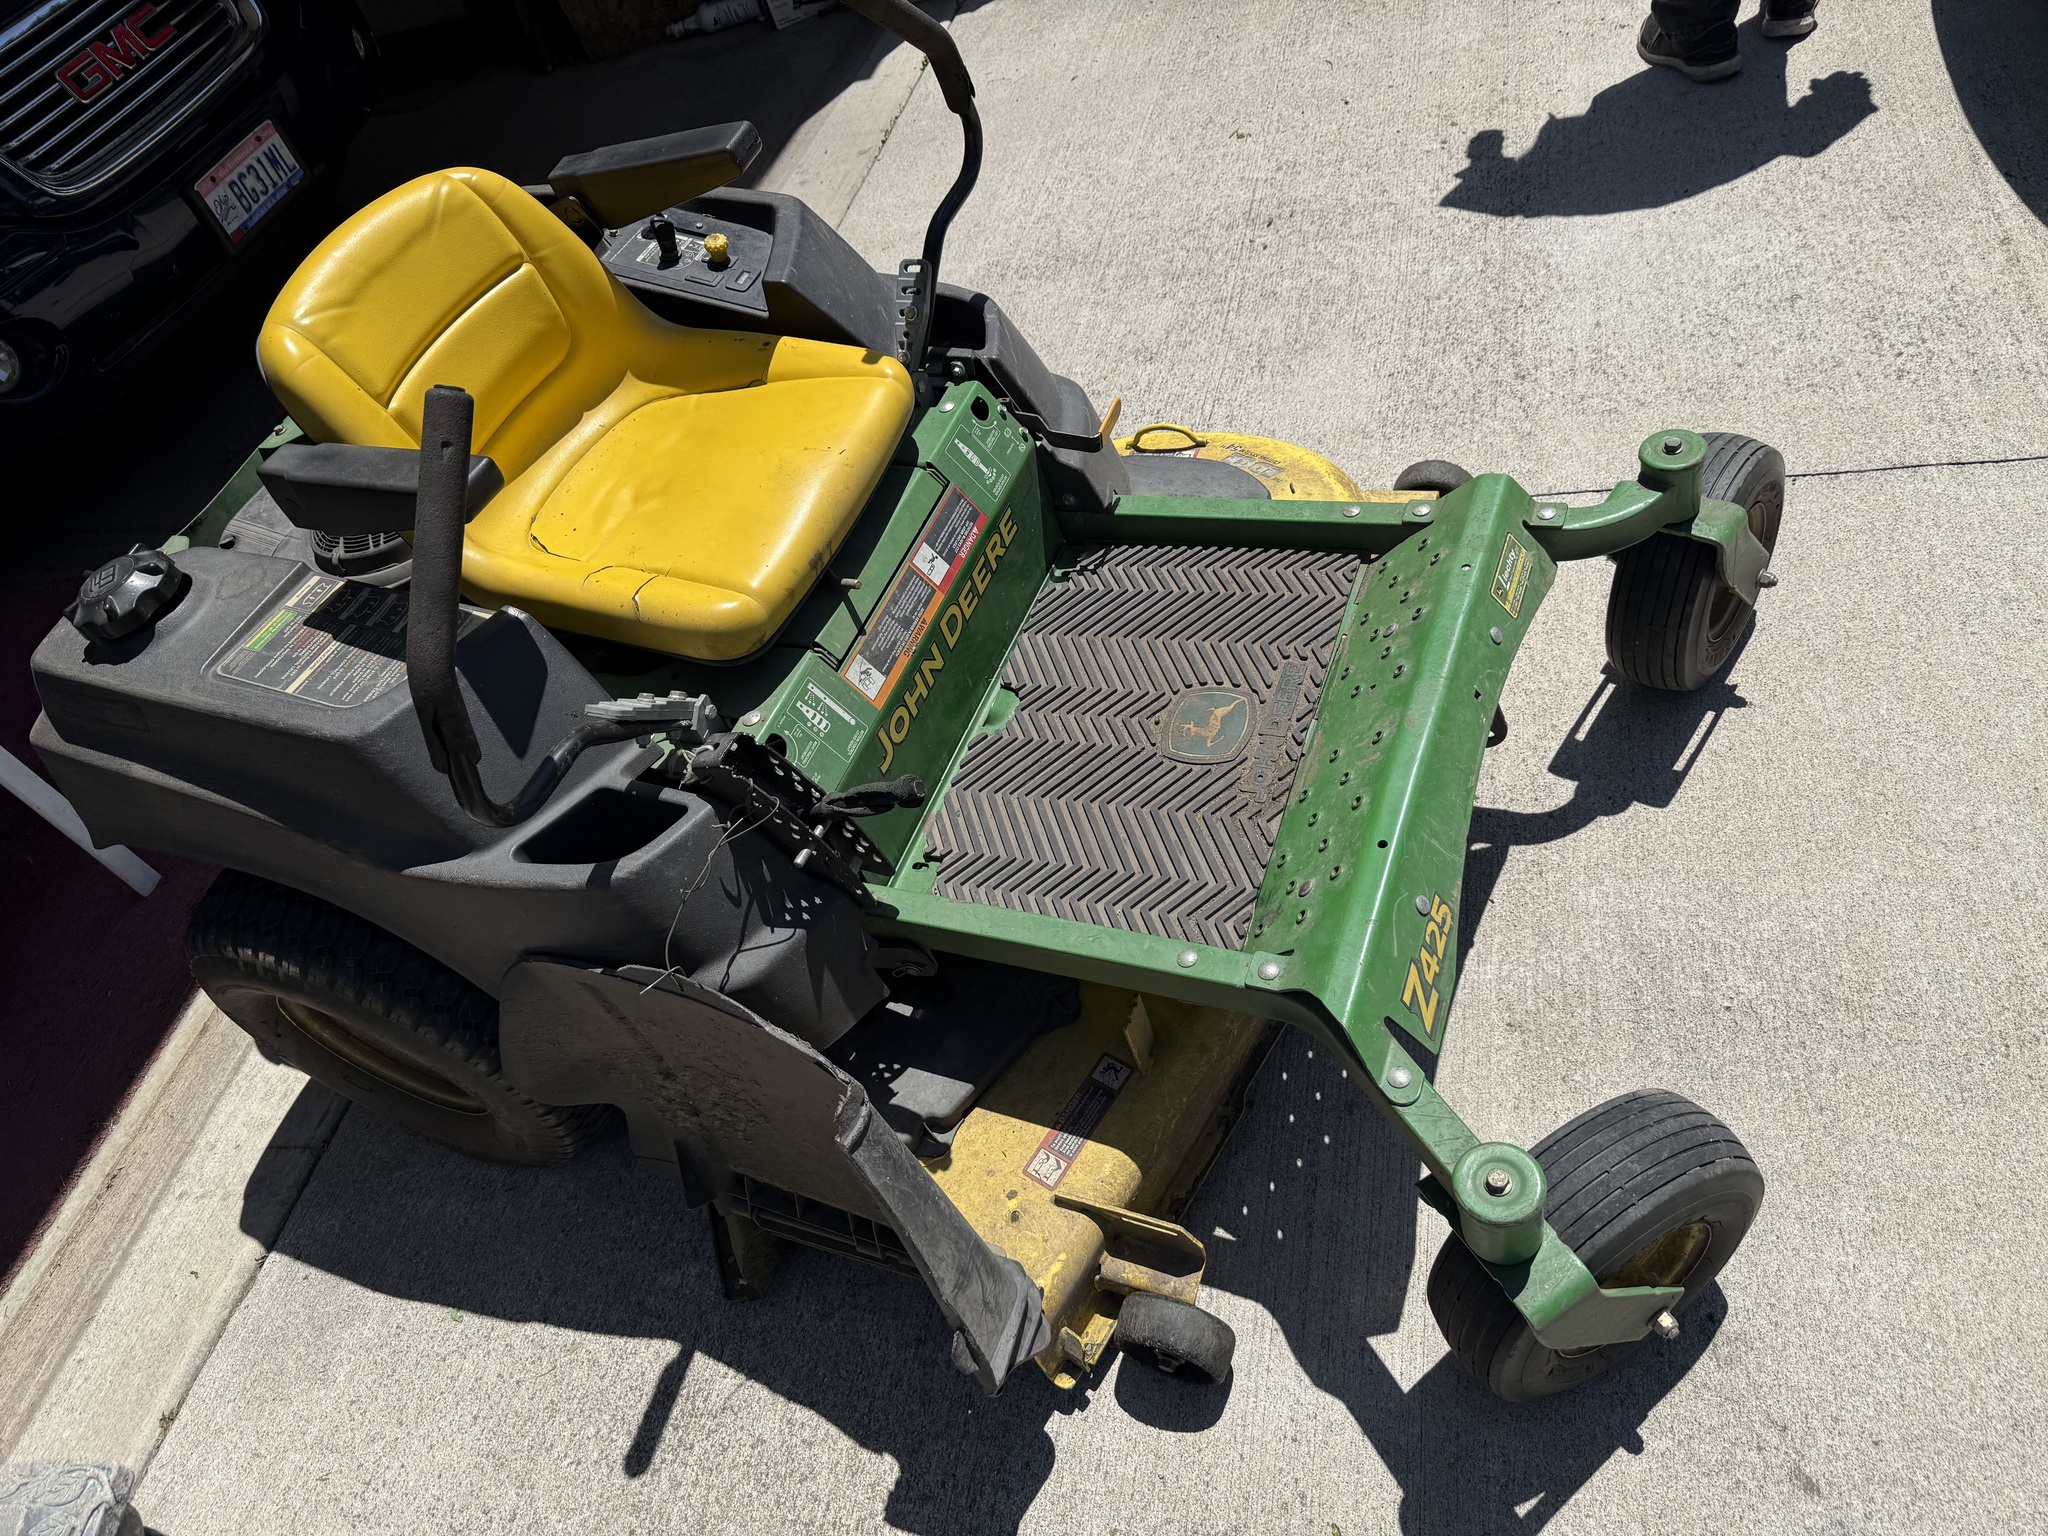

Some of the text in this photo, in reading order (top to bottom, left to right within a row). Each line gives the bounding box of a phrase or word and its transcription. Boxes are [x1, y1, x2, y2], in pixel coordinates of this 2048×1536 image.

[55, 4, 177, 103] GMC
[213, 192, 229, 216] Ohio
[958, 532, 976, 558] DANGER
[878, 642, 946, 775] JOHN
[939, 505, 1019, 651] DEERE
[902, 623, 925, 657] WARNING
[1239, 660, 1307, 803] JOHN DEERE
[1402, 894, 1453, 1035] Z425
[1059, 1092, 1082, 1122] DANGER
